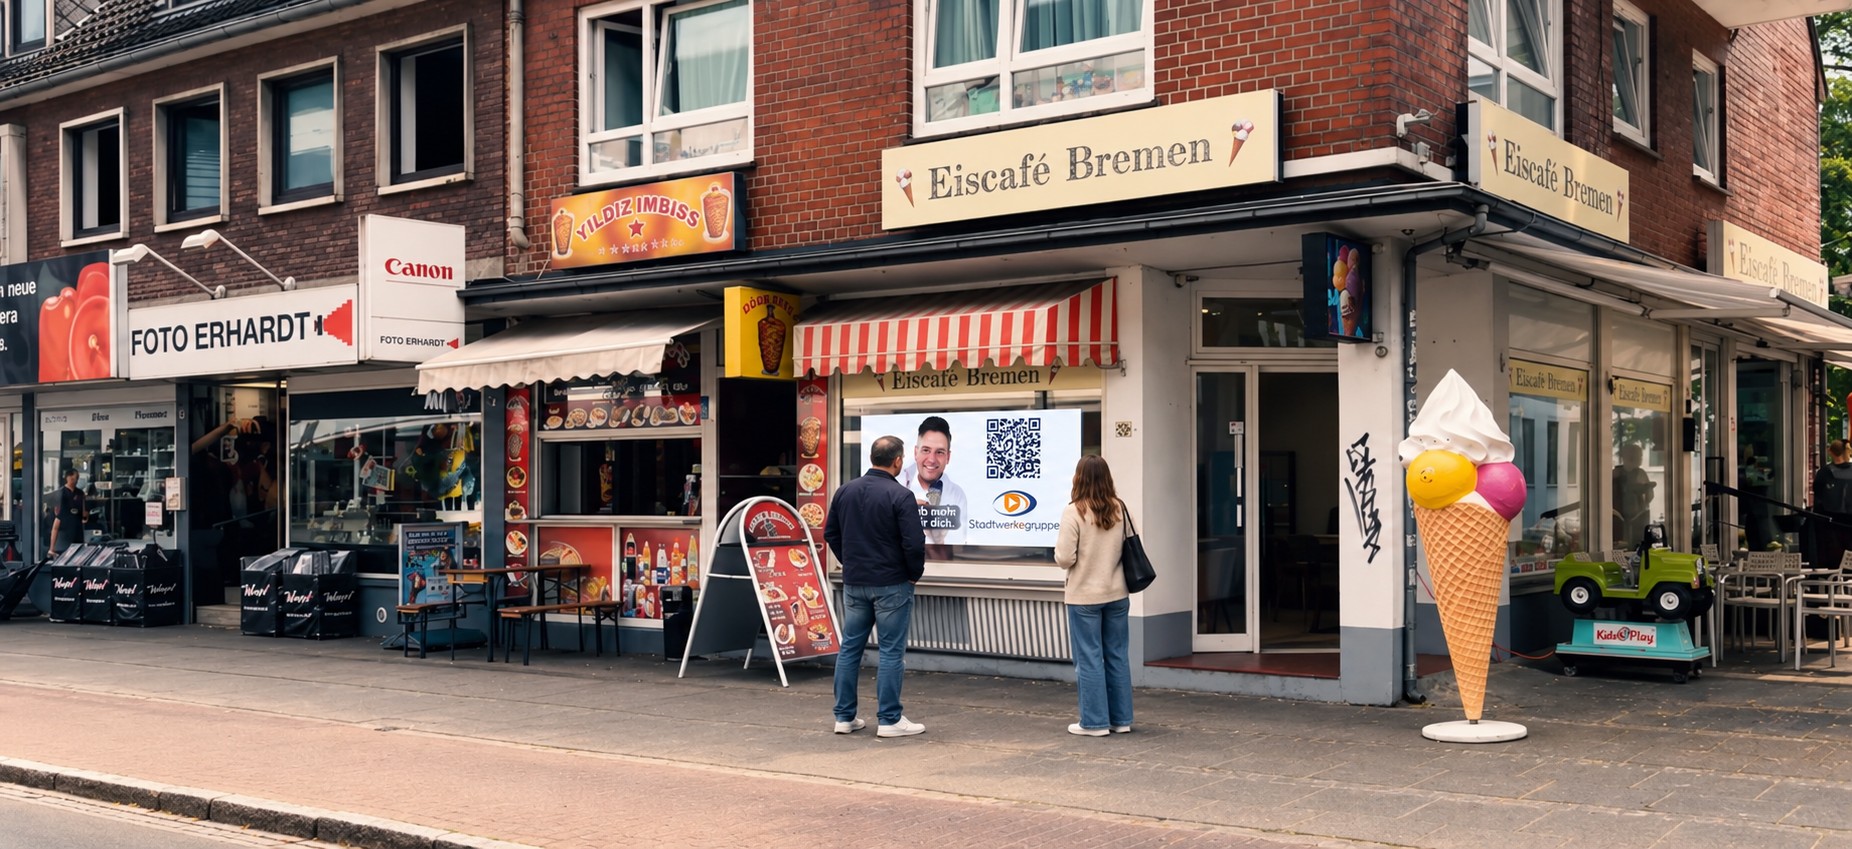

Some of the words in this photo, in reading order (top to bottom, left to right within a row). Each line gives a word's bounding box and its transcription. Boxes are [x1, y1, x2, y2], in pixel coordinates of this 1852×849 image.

[928, 153, 1050, 200] Eiscafé
[1066, 137, 1213, 182] Bremen
[1503, 138, 1558, 192] Eiscafé
[1563, 165, 1613, 215] Bremen
[576, 198, 632, 241] YILDIZ
[636, 196, 700, 228] IMBISS
[384, 258, 453, 280] Canon
[1739, 241, 1778, 285] Eiscafé
[1782, 260, 1817, 302] Bremen
[8, 281, 37, 297] neue
[131, 324, 188, 356] FOTO
[195, 311, 310, 350] ERHARDT
[380, 335, 404, 345] FOTO
[406, 337, 445, 347] ERHARDT
[967, 368, 1040, 387] Bremen
[1516, 368, 1545, 388] Eiscafé
[1547, 372, 1576, 393] Bremen
[930, 517, 955, 528] dich.
[968, 519, 1060, 532] Stadtwerkegruppe
[1629, 630, 1654, 645] Play
